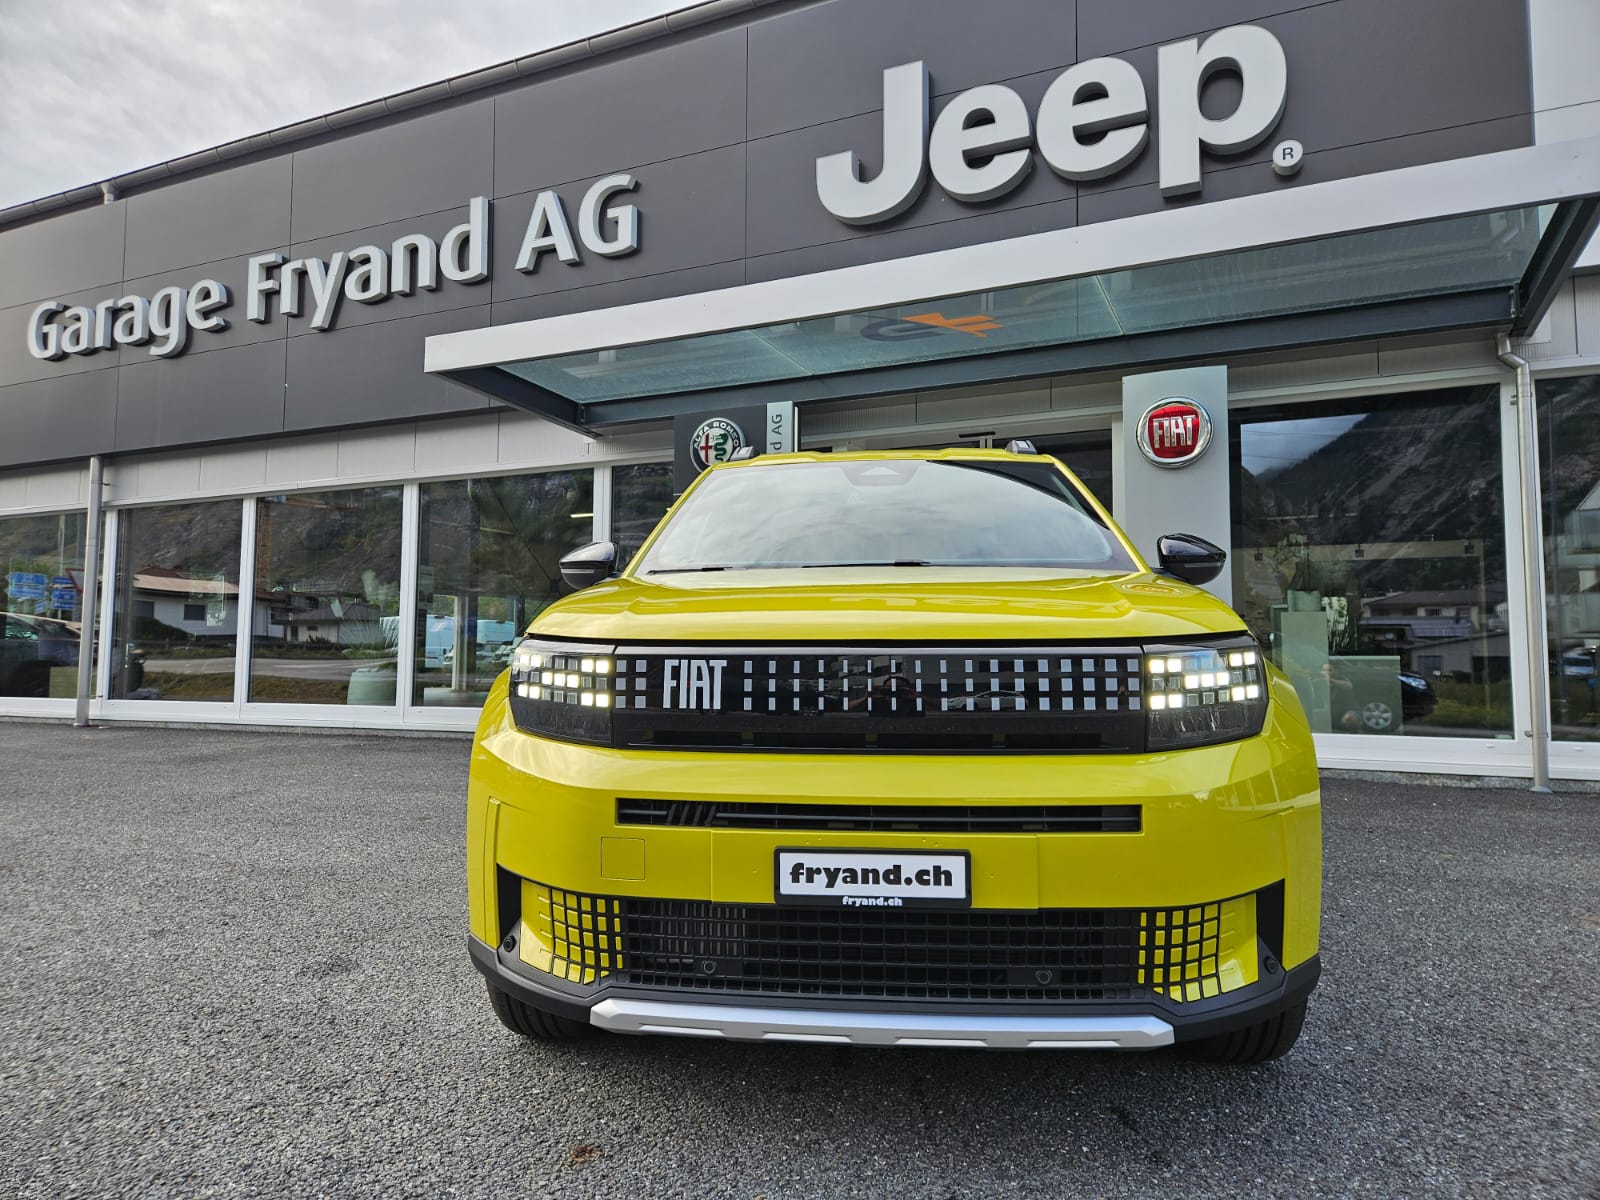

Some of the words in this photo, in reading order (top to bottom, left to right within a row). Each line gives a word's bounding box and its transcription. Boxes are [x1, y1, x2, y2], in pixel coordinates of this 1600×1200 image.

[815, 24, 1288, 226] Jeep
[27, 278, 228, 358] Garage
[246, 195, 489, 330] Fryand
[514, 173, 639, 273] AG
[693, 425, 710, 449] ALFA
[712, 421, 740, 447] ROMEO
[771, 414, 783, 436] AG
[1152, 414, 1197, 449] FIAT
[662, 659, 728, 710] FIAT
[789, 862, 953, 889] fryand.ch
[842, 895, 903, 907] fryand.ch
